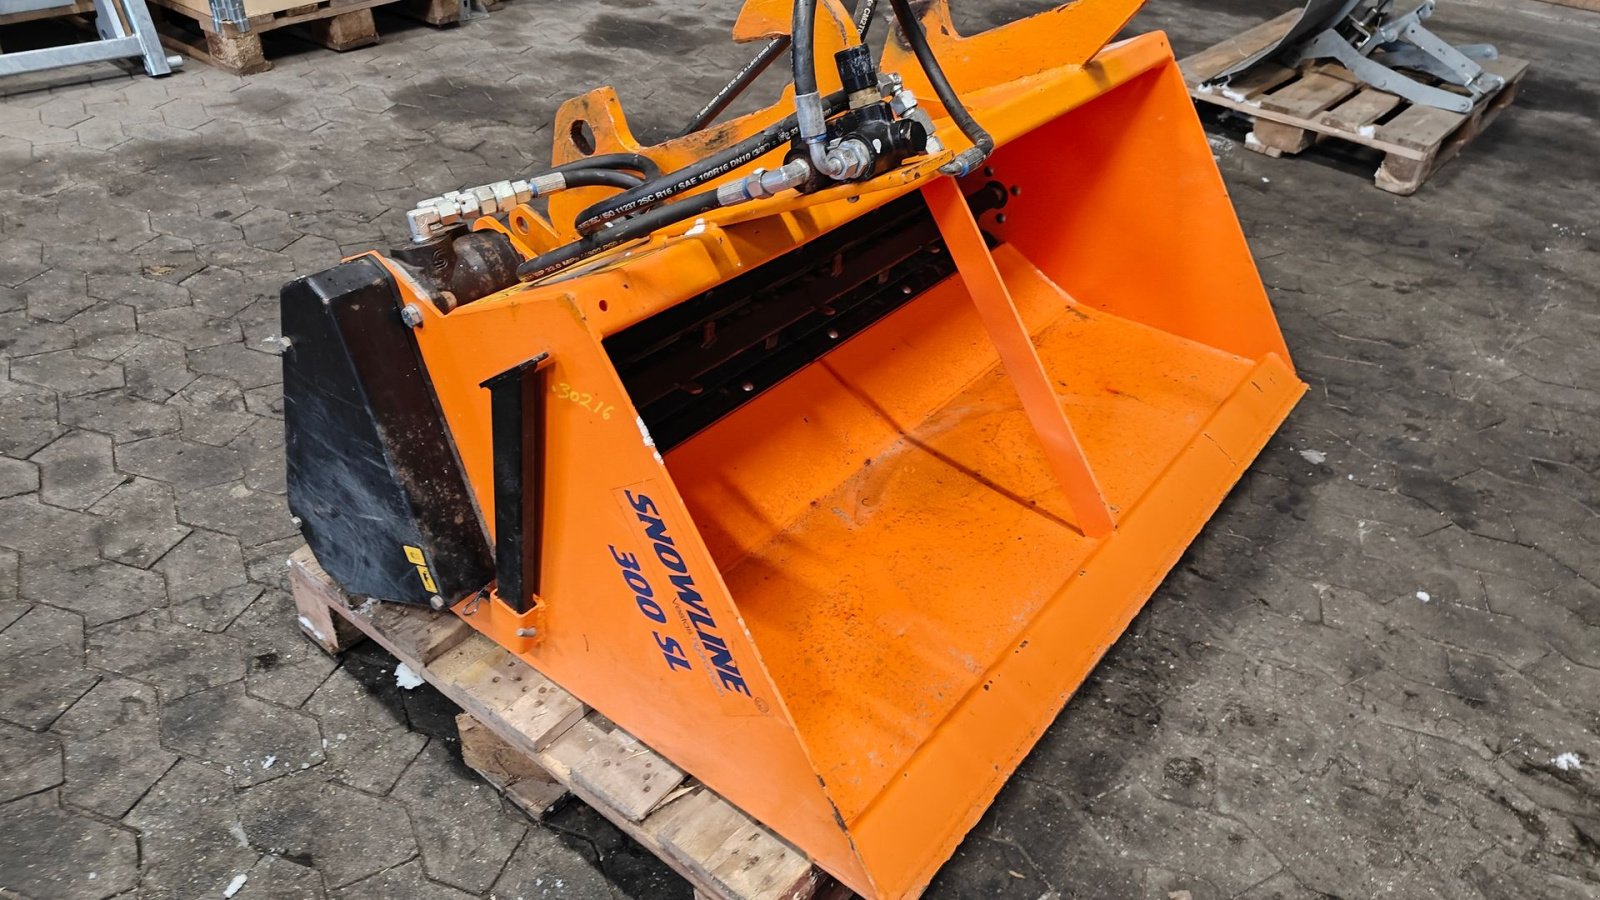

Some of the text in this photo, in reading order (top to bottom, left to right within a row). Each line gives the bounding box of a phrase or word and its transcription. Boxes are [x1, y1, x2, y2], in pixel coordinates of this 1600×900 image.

[614, 202, 636, 214] 11237
[637, 195, 655, 206] 2SC
[655, 188, 673, 199] R16
[678, 177, 698, 190] SAE
[699, 163, 729, 182] 100R16
[729, 152, 751, 168] DN10
[608, 544, 692, 673] 300 SL
[624, 489, 753, 698] SNOWLINE
